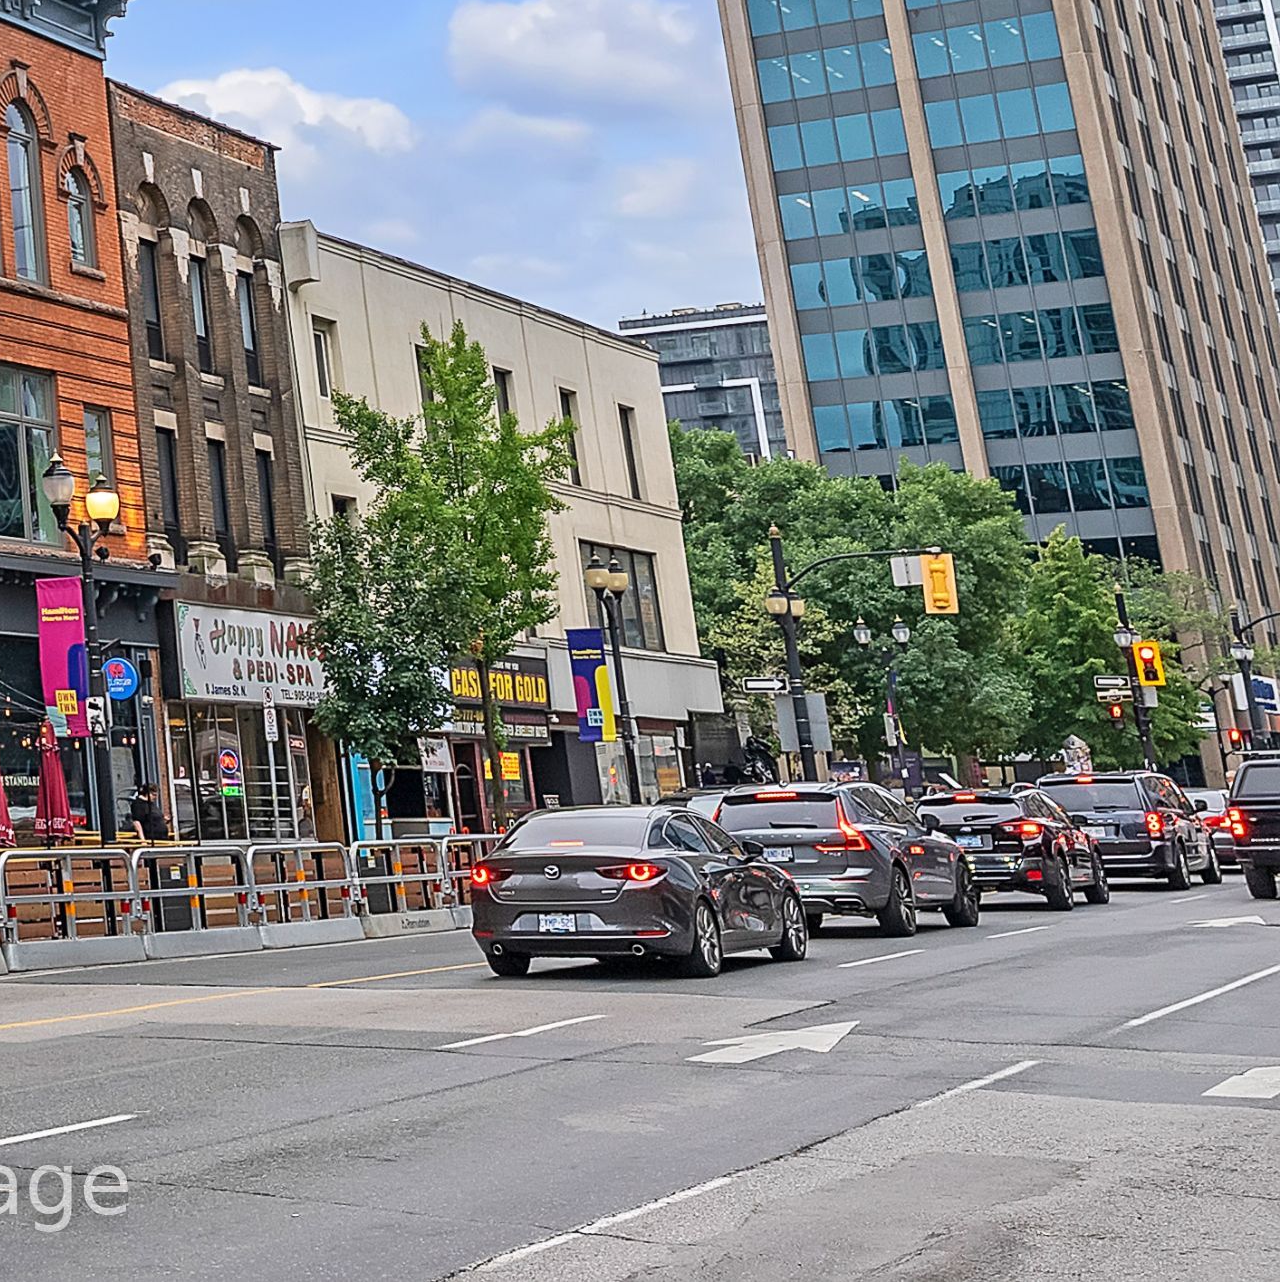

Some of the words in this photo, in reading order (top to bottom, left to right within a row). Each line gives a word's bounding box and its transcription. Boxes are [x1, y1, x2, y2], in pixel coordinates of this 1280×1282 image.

[41, 607, 79, 615] Hamilton
[209, 619, 264, 657] Happy
[233, 657, 243, 680] &
[211, 683, 231, 695] James
[489, 671, 514, 700] FOR
[515, 675, 547, 703] GOLD
[59, 703, 77, 712] TWN
